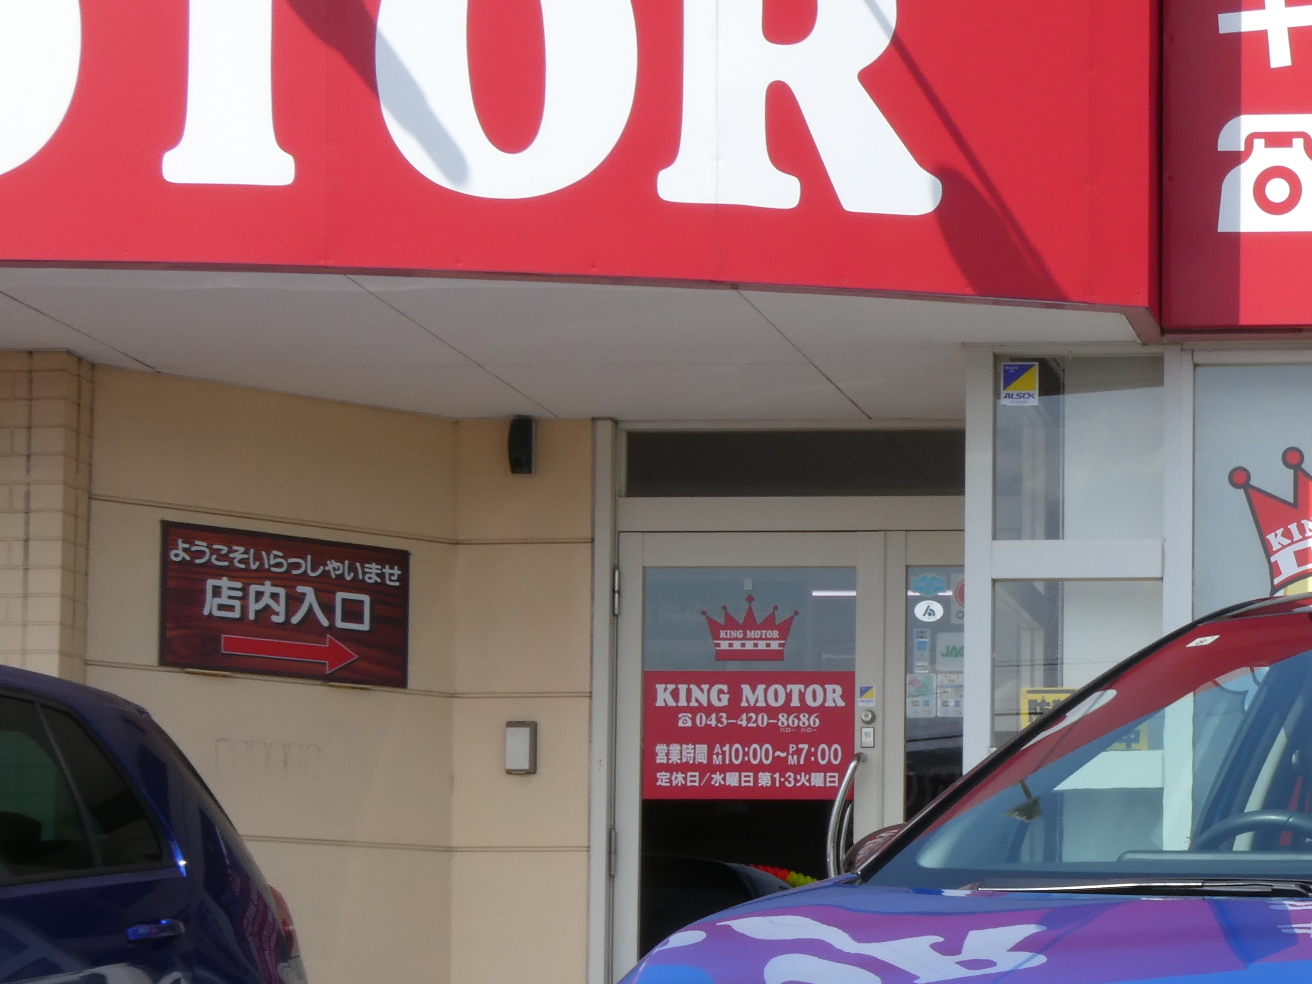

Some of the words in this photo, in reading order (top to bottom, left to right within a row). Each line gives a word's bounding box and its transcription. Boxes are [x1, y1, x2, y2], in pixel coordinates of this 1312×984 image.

[1003, 392, 1036, 400] ALSOK
[203, 577, 371, 632] 店内入口
[719, 629, 744, 639] KING
[746, 629, 780, 639] MOTOR
[655, 684, 730, 707] KING
[740, 684, 846, 707] MOTOR
[695, 712, 820, 728] 043-420-8686
[655, 743, 708, 765] 営業時間
